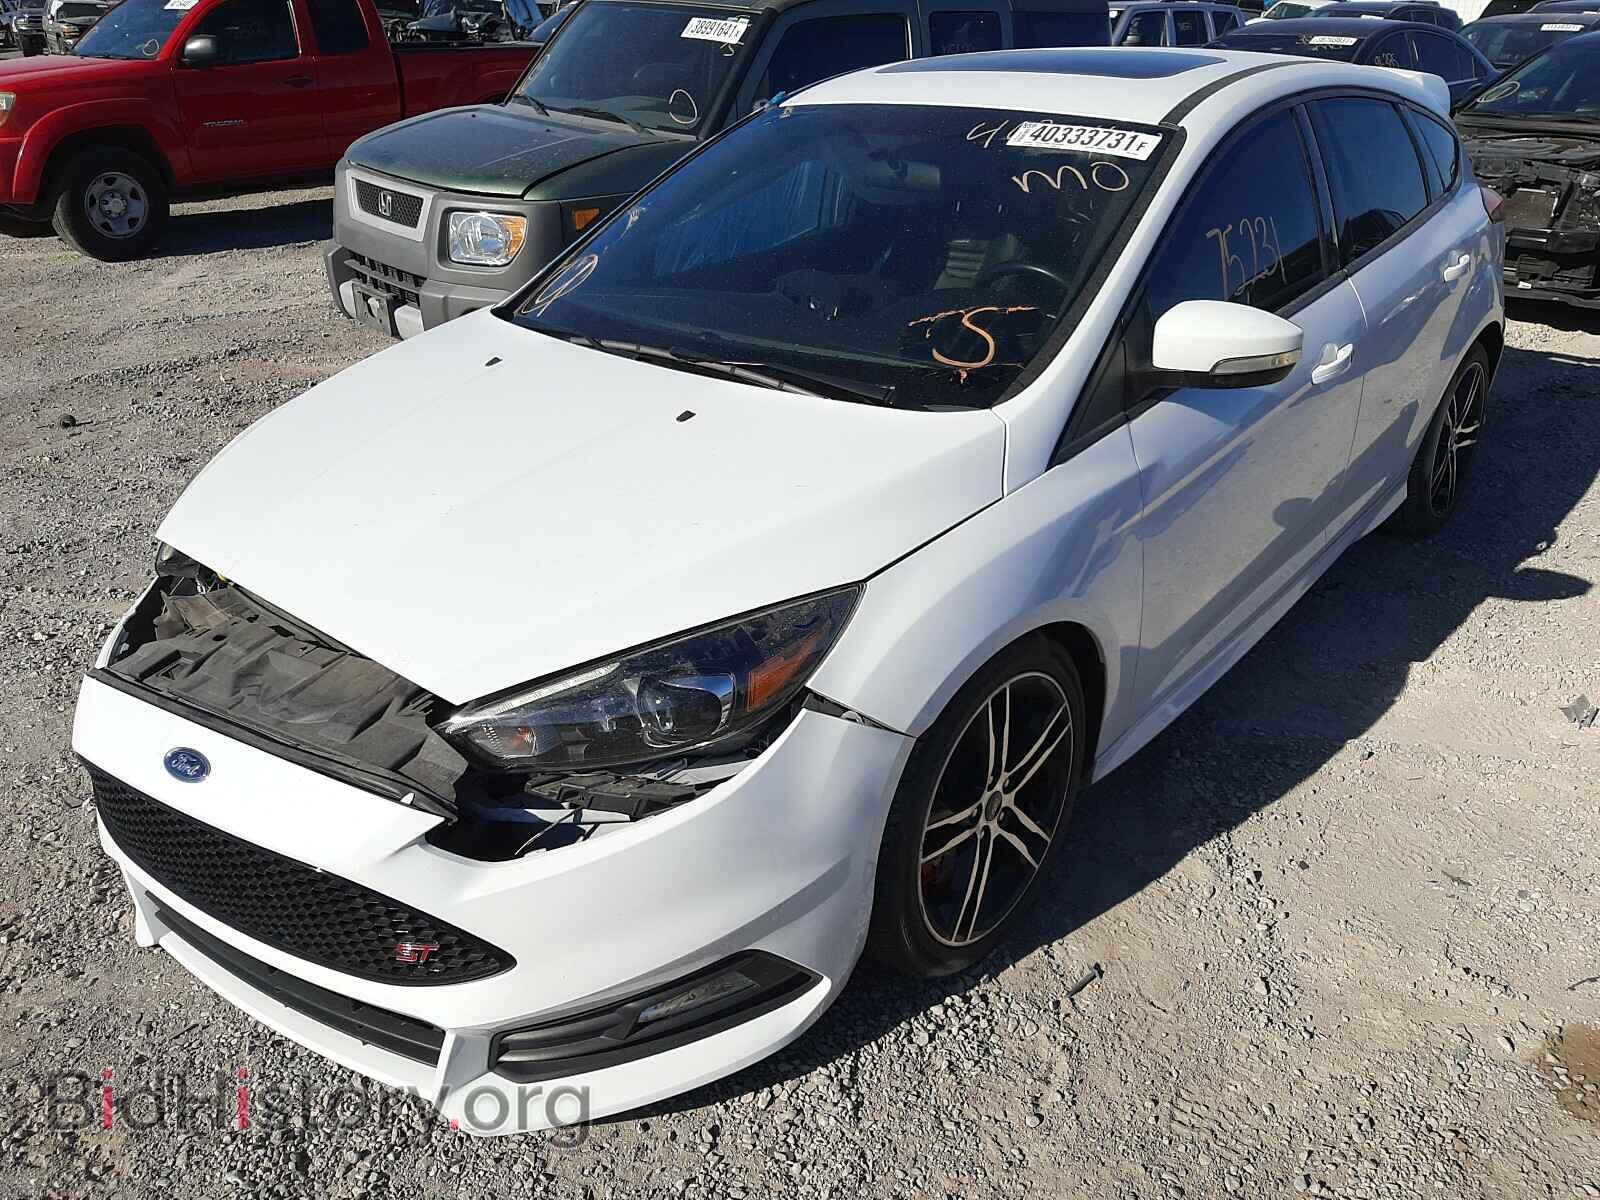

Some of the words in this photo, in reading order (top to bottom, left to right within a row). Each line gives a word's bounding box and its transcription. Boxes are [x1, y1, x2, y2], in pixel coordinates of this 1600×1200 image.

[1029, 125, 1140, 152] 40333731
[171, 752, 201, 777] Ford
[395, 943, 440, 962] ST
